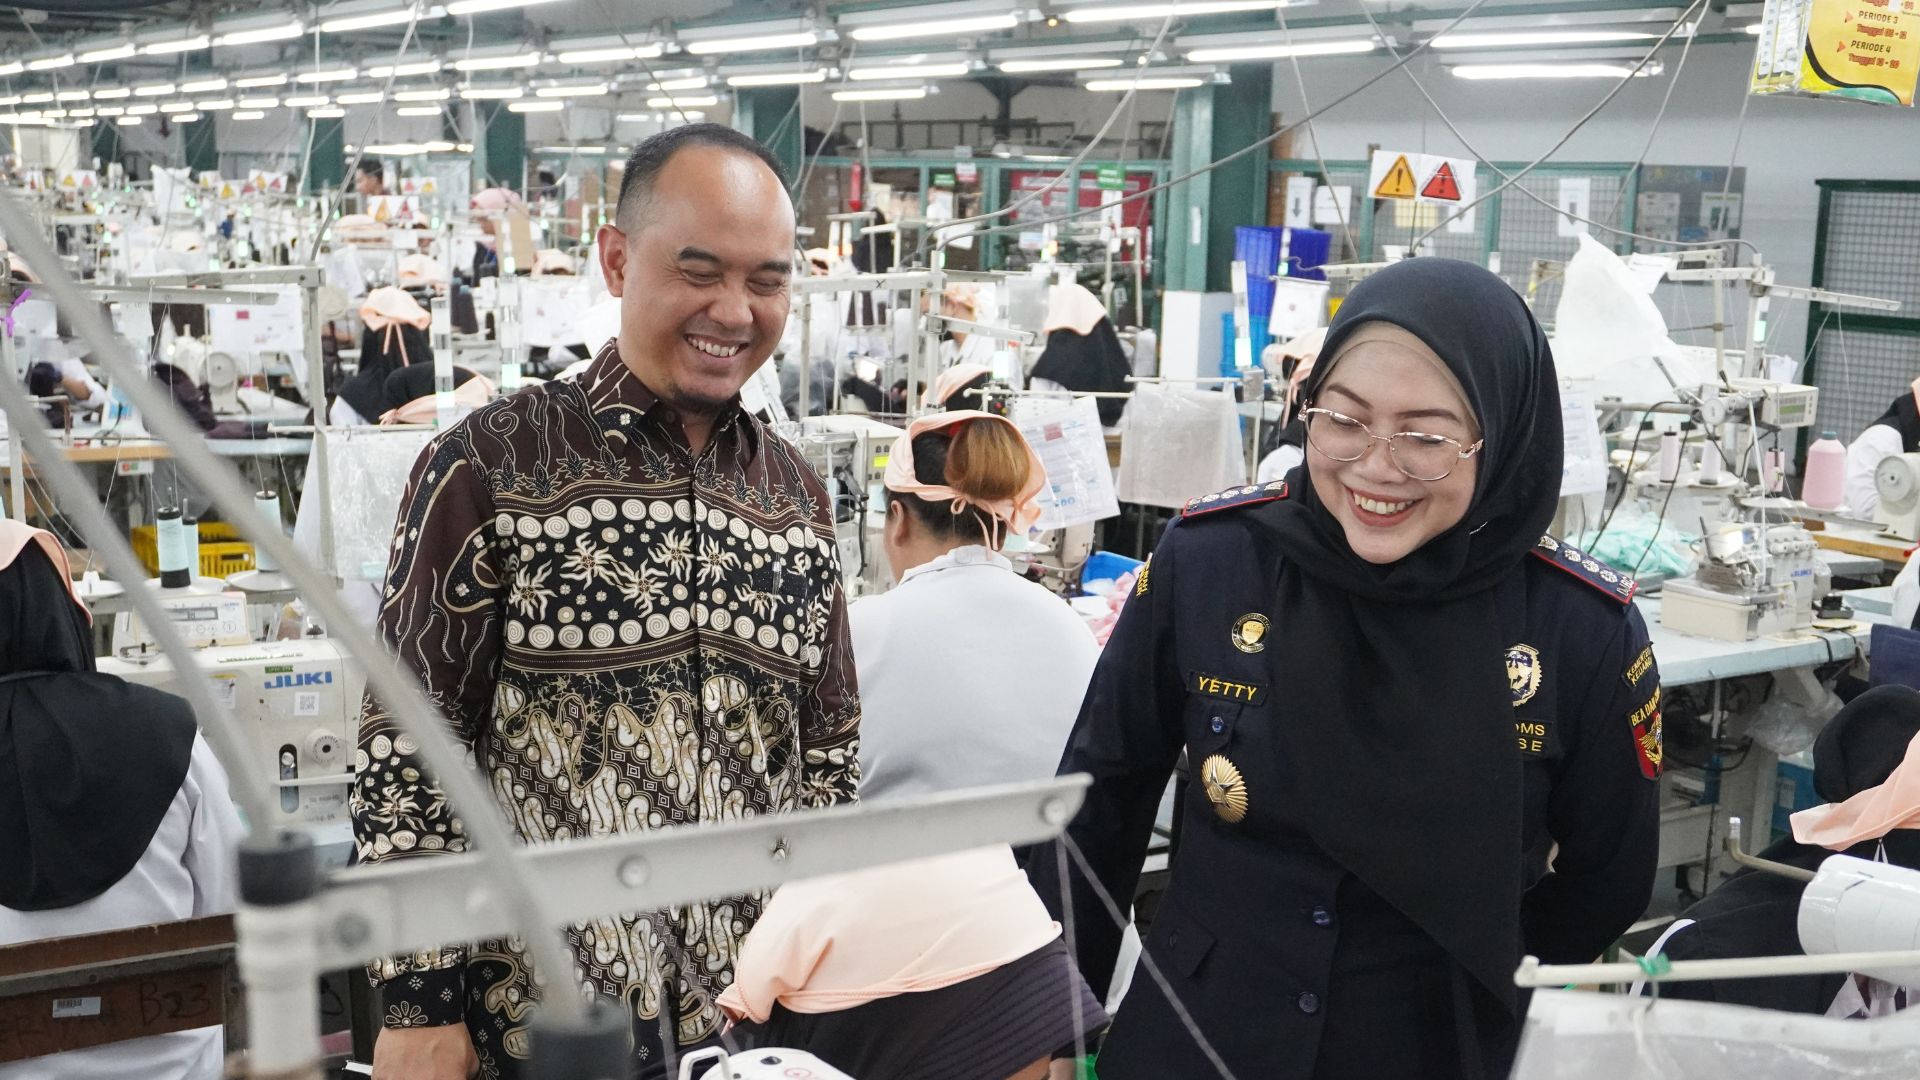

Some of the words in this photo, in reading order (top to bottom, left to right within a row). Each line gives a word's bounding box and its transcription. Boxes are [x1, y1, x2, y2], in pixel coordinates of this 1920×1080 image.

[1859, 10, 1892, 23] PERIODE
[1893, 16, 1899, 24] 3
[1850, 40, 1885, 53] PERIODE
[264, 671, 333, 689] JUKI
[1199, 676, 1257, 701] YETTY
[1631, 707, 1647, 727] BEA
